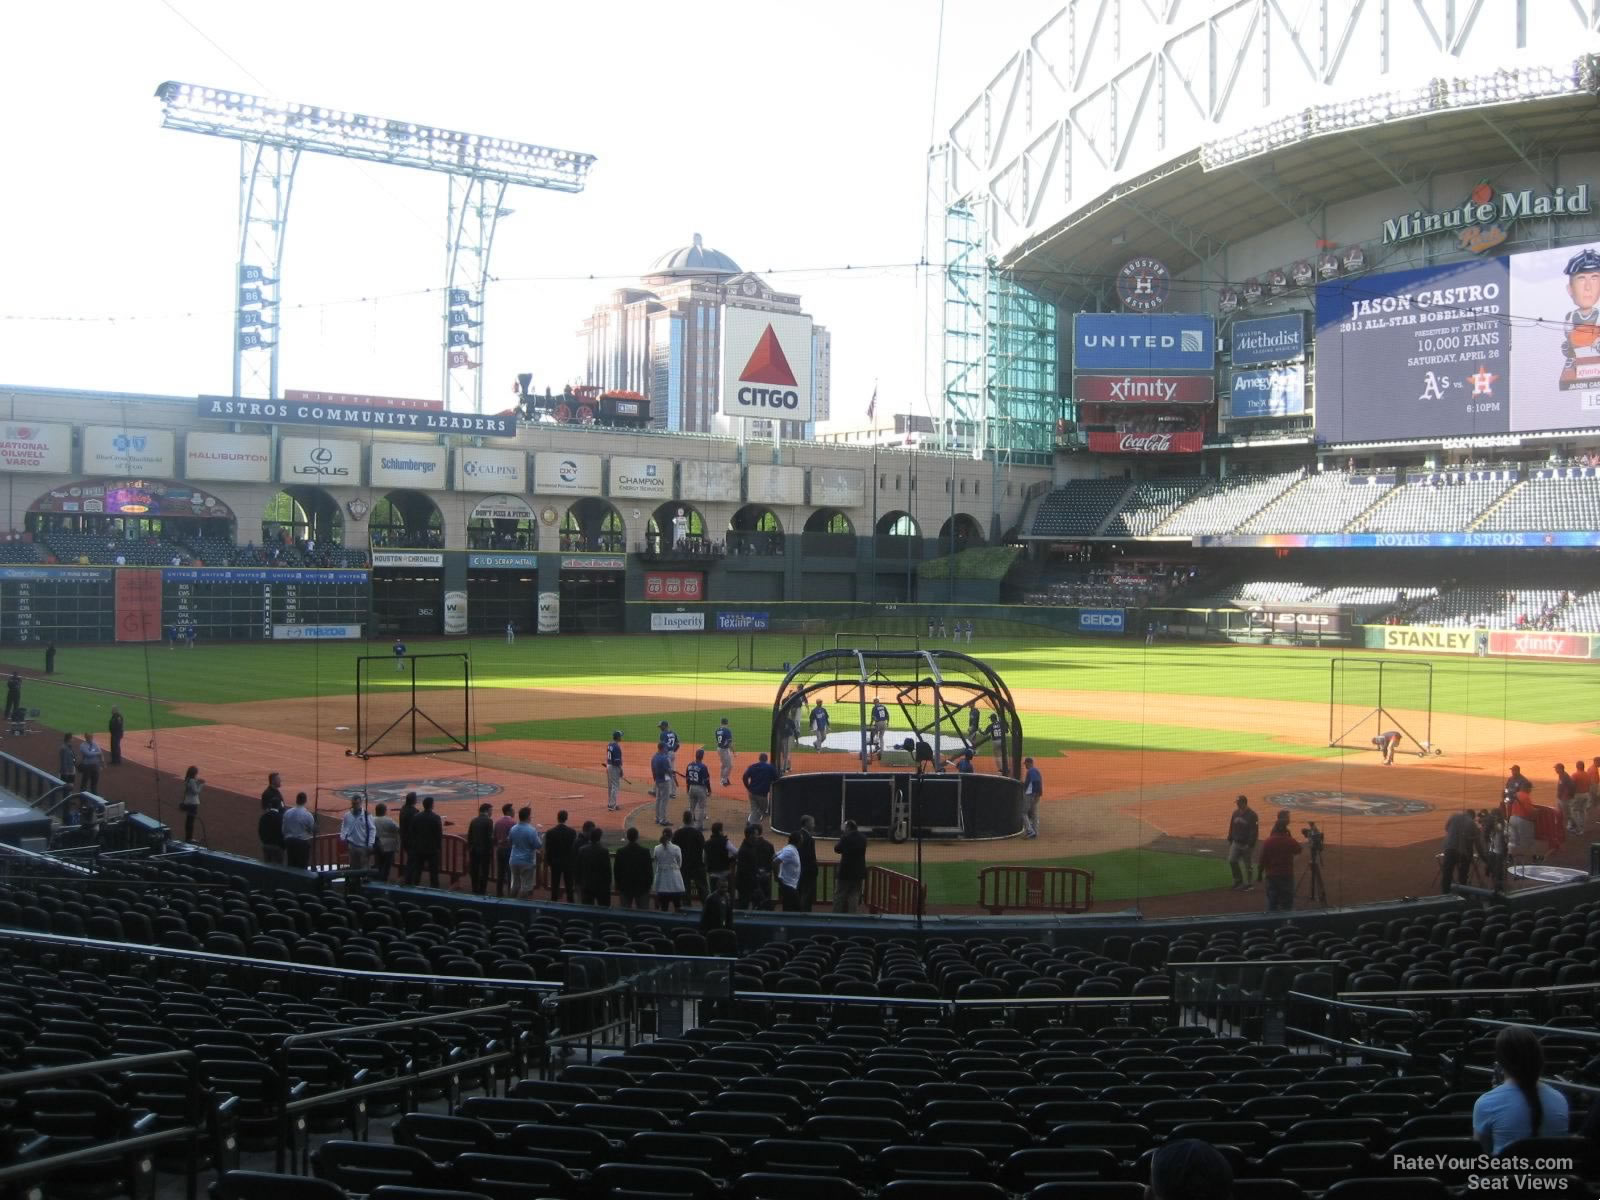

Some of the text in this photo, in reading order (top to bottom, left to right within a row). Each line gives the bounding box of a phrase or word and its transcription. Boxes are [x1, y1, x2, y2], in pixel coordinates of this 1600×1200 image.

[1382, 184, 1589, 244] Minute Maid
[1124, 260, 1164, 275] HOUSTON
[1134, 276, 1154, 294] H
[1125, 296, 1162, 309] ASTROS
[1352, 283, 1499, 320] JASON CASTRO
[1340, 305, 1499, 333] 2013 ALL-STAR BOBBLEHEAD
[1462, 319, 1499, 333] XFINITY
[245, 336, 257, 344] 98
[1084, 335, 1175, 348] UNITED
[1236, 330, 1300, 350] Methodist
[1418, 331, 1499, 352] 10,000 FANS
[1408, 349, 1500, 367] SATURDAY, APRIL 26
[1110, 378, 1176, 401] xfinity
[1472, 373, 1492, 394] H
[738, 387, 799, 409] CITGO
[1467, 402, 1500, 413] 6:10PM
[211, 401, 506, 431] ASTROS COMMUNITY LEADERS
[1, 451, 45, 459] OILWELL
[6, 458, 40, 466] VARCO
[189, 452, 268, 462] HALLIBURTON
[293, 465, 349, 476] LEXUS
[381, 457, 437, 473] Schlumberger
[478, 465, 519, 475] CALPINE
[619, 476, 665, 486] CHAMPION
[1376, 533, 1524, 546] ROYALS ASTROS
[375, 555, 440, 563] HOUSTON CHRONICLE
[664, 616, 703, 629] Insperity
[1080, 614, 1122, 626] GEICO
[1388, 631, 1470, 649] STANLEY
[1515, 635, 1564, 655] xfinity
[689, 771, 699, 781] 59
